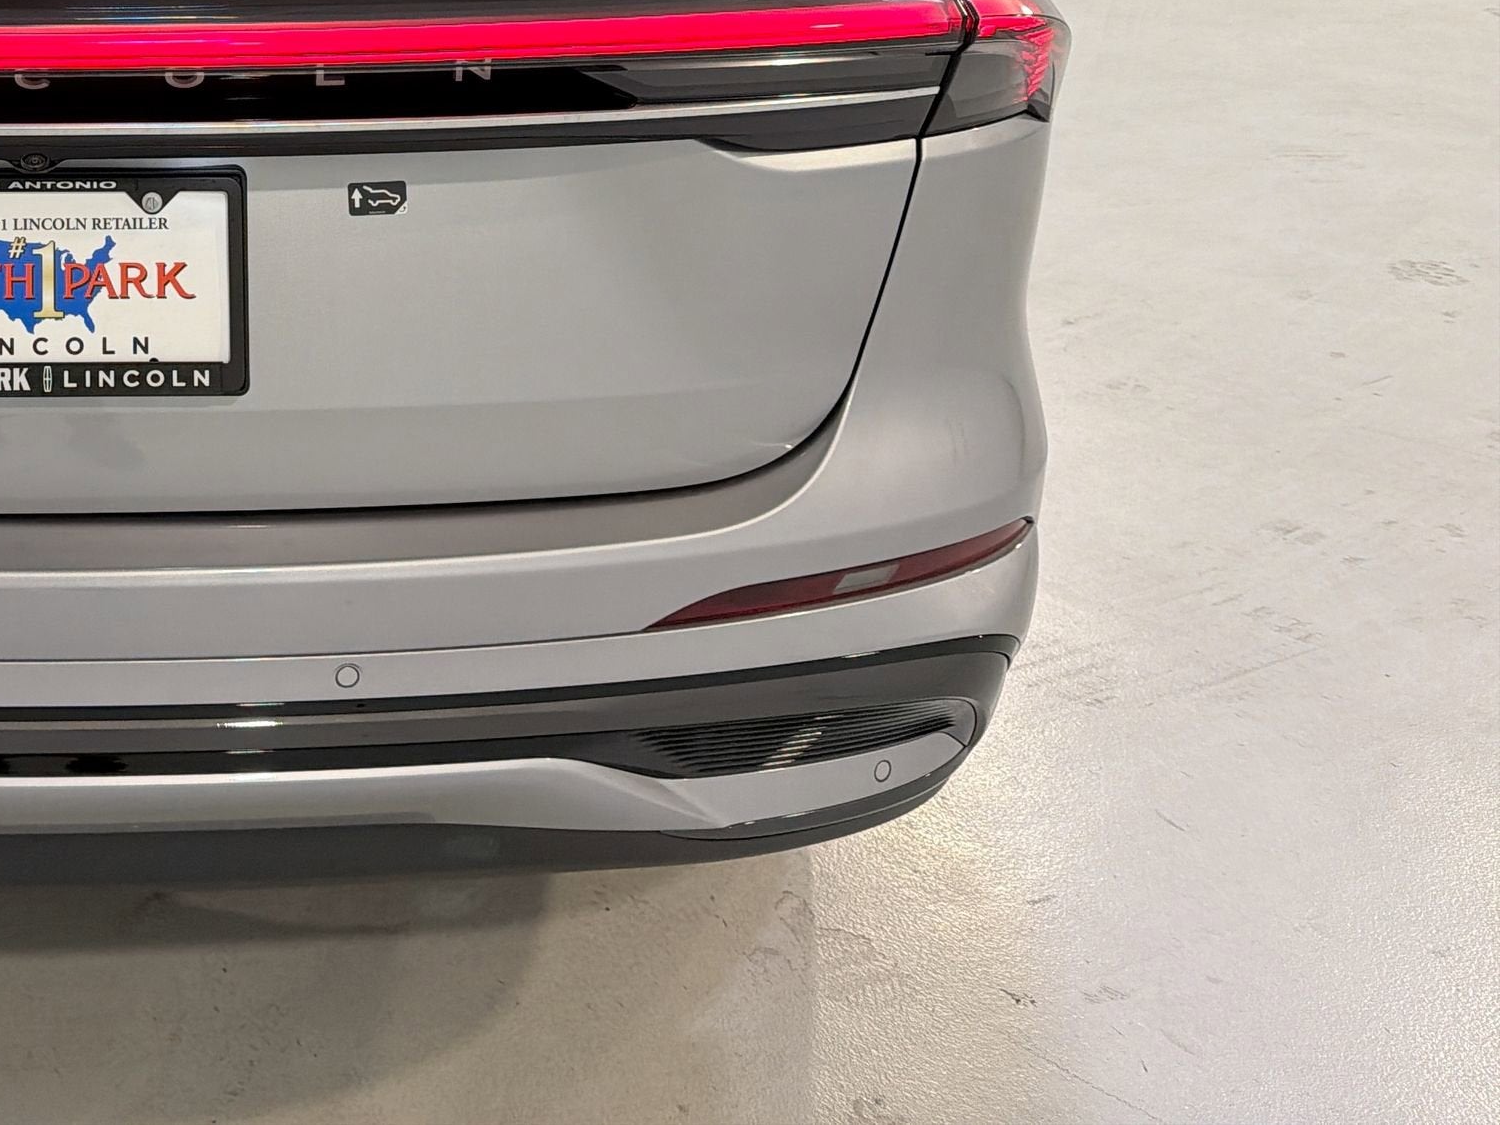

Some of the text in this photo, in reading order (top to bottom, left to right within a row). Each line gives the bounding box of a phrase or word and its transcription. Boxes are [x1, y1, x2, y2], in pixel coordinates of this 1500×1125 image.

[8, 180, 117, 190] ANTONIO
[13, 217, 87, 231] LINCOLN
[92, 217, 169, 230] RETAILER
[63, 262, 197, 300] PARK
[63, 369, 210, 388] LINCOLN
